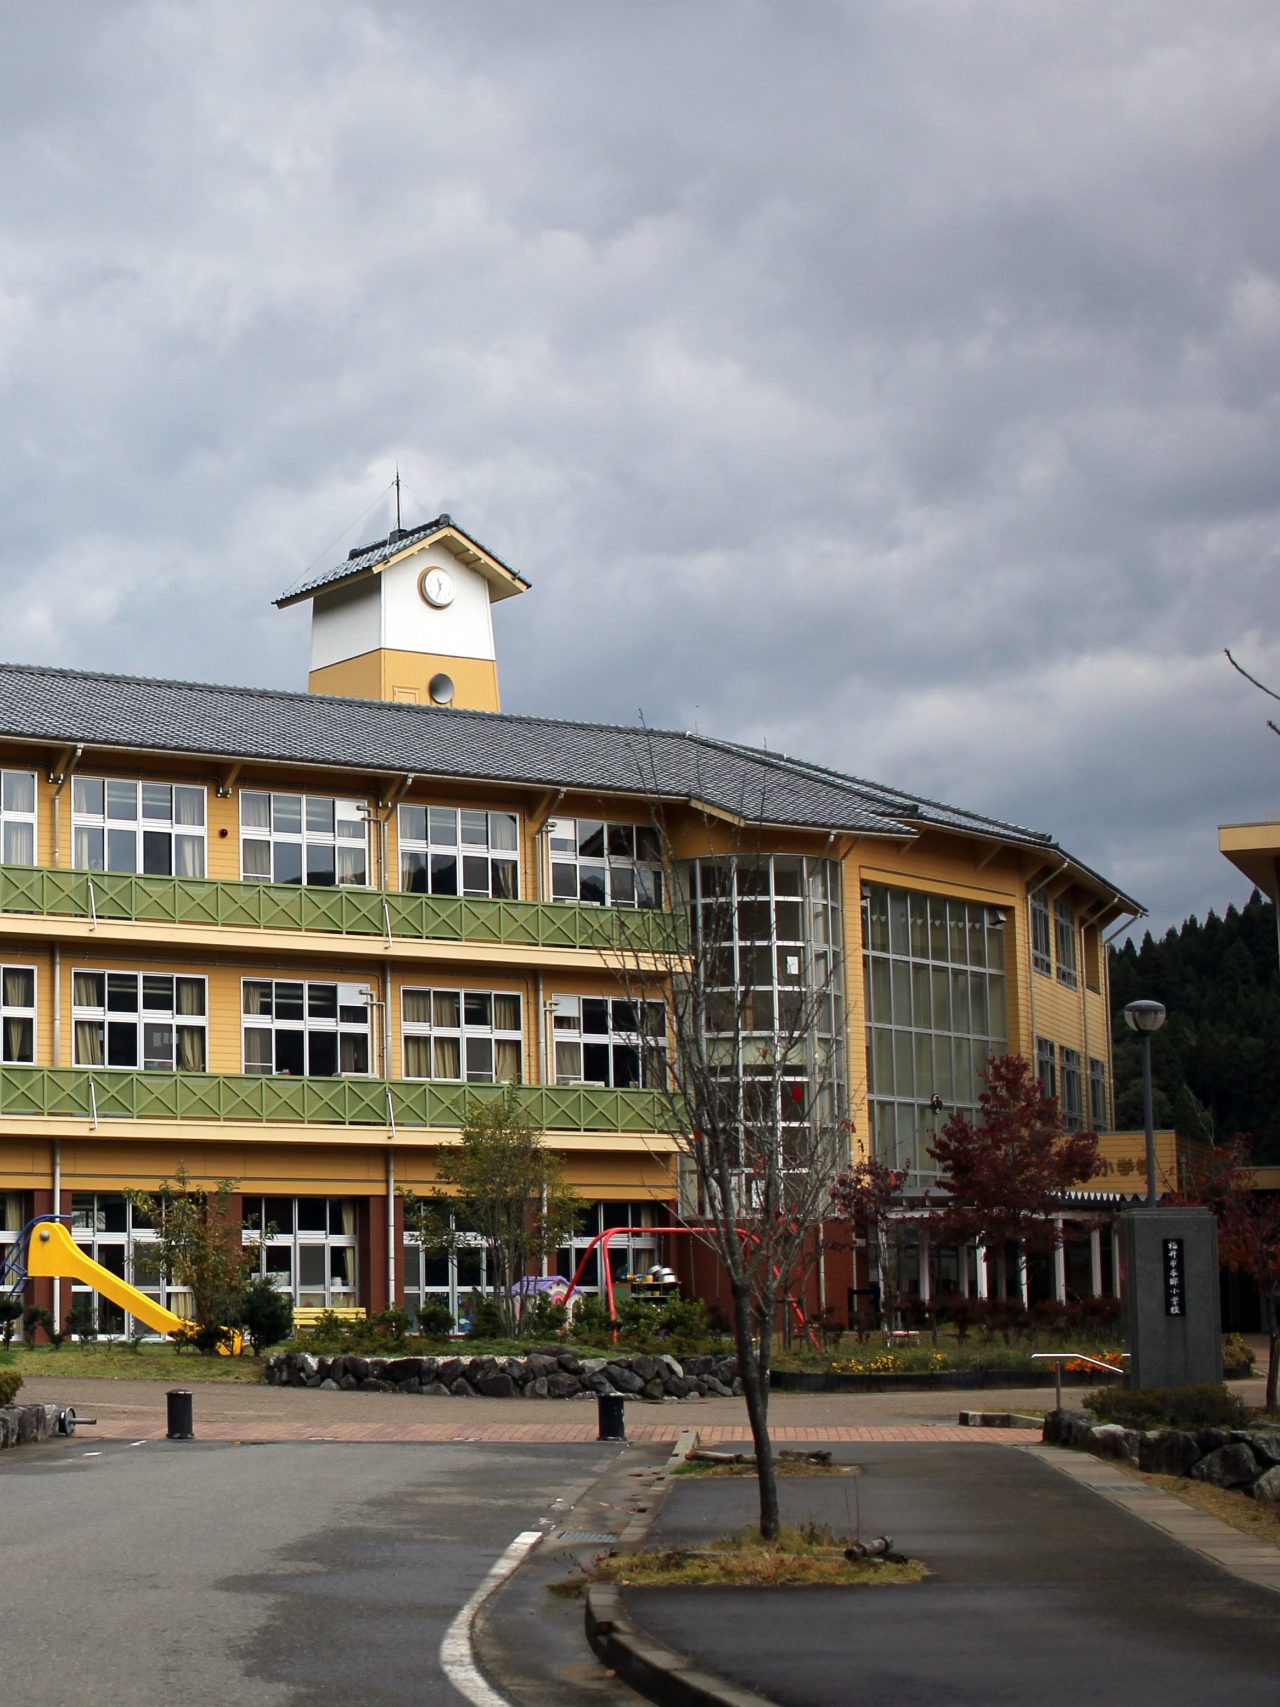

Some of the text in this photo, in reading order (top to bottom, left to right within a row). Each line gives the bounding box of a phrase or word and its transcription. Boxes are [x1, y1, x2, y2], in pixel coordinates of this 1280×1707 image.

[1168, 1241, 1181, 1315] 福井市本郷小学校
